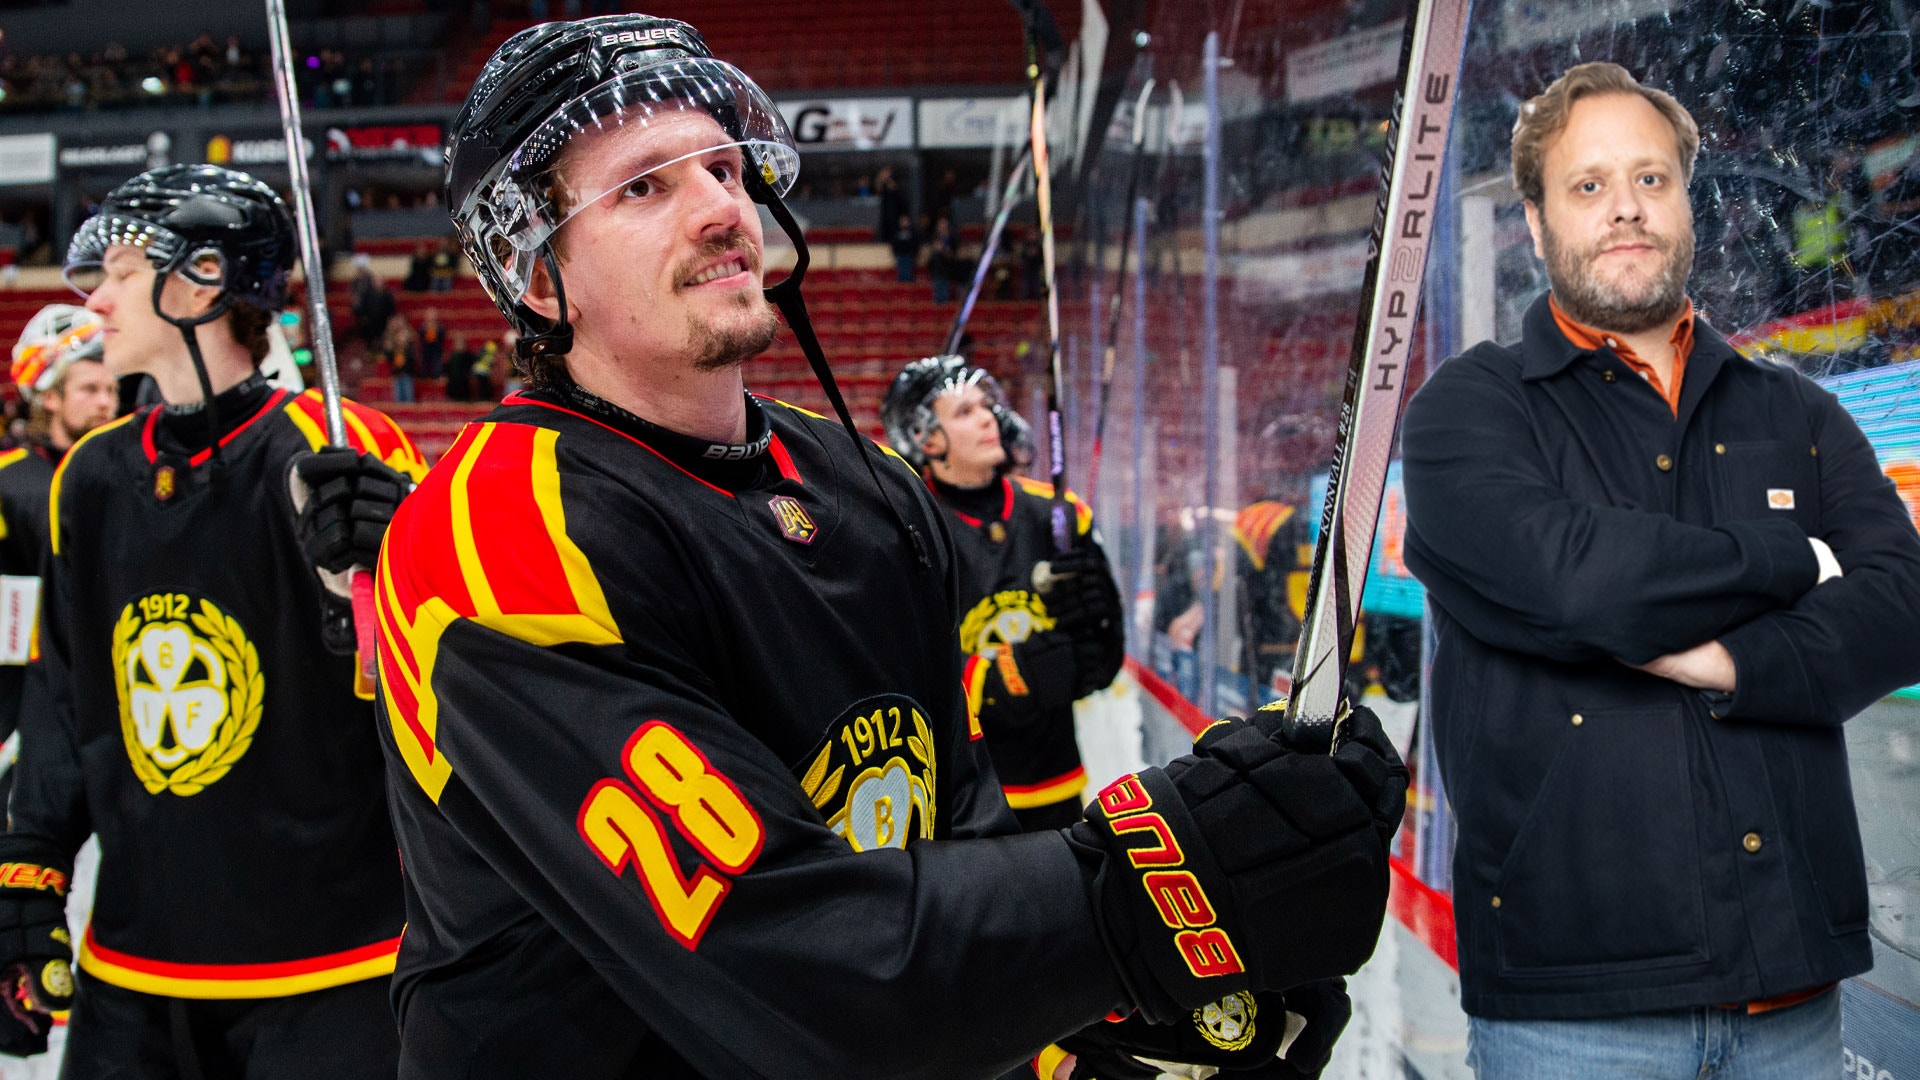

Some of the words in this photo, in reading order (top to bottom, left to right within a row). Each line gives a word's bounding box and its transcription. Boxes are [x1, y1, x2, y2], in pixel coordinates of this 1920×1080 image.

[602, 28, 680, 48] BAUER
[1320, 442, 1345, 537] KINNVALL
[1338, 402, 1351, 436] #28
[139, 593, 190, 621] 1912
[158, 642, 174, 670] B
[143, 701, 149, 730] I
[186, 701, 203, 730] F
[841, 706, 903, 766] 1912
[576, 720, 766, 952] 28
[873, 795, 895, 848] B
[1097, 774, 1246, 978] BAUE
